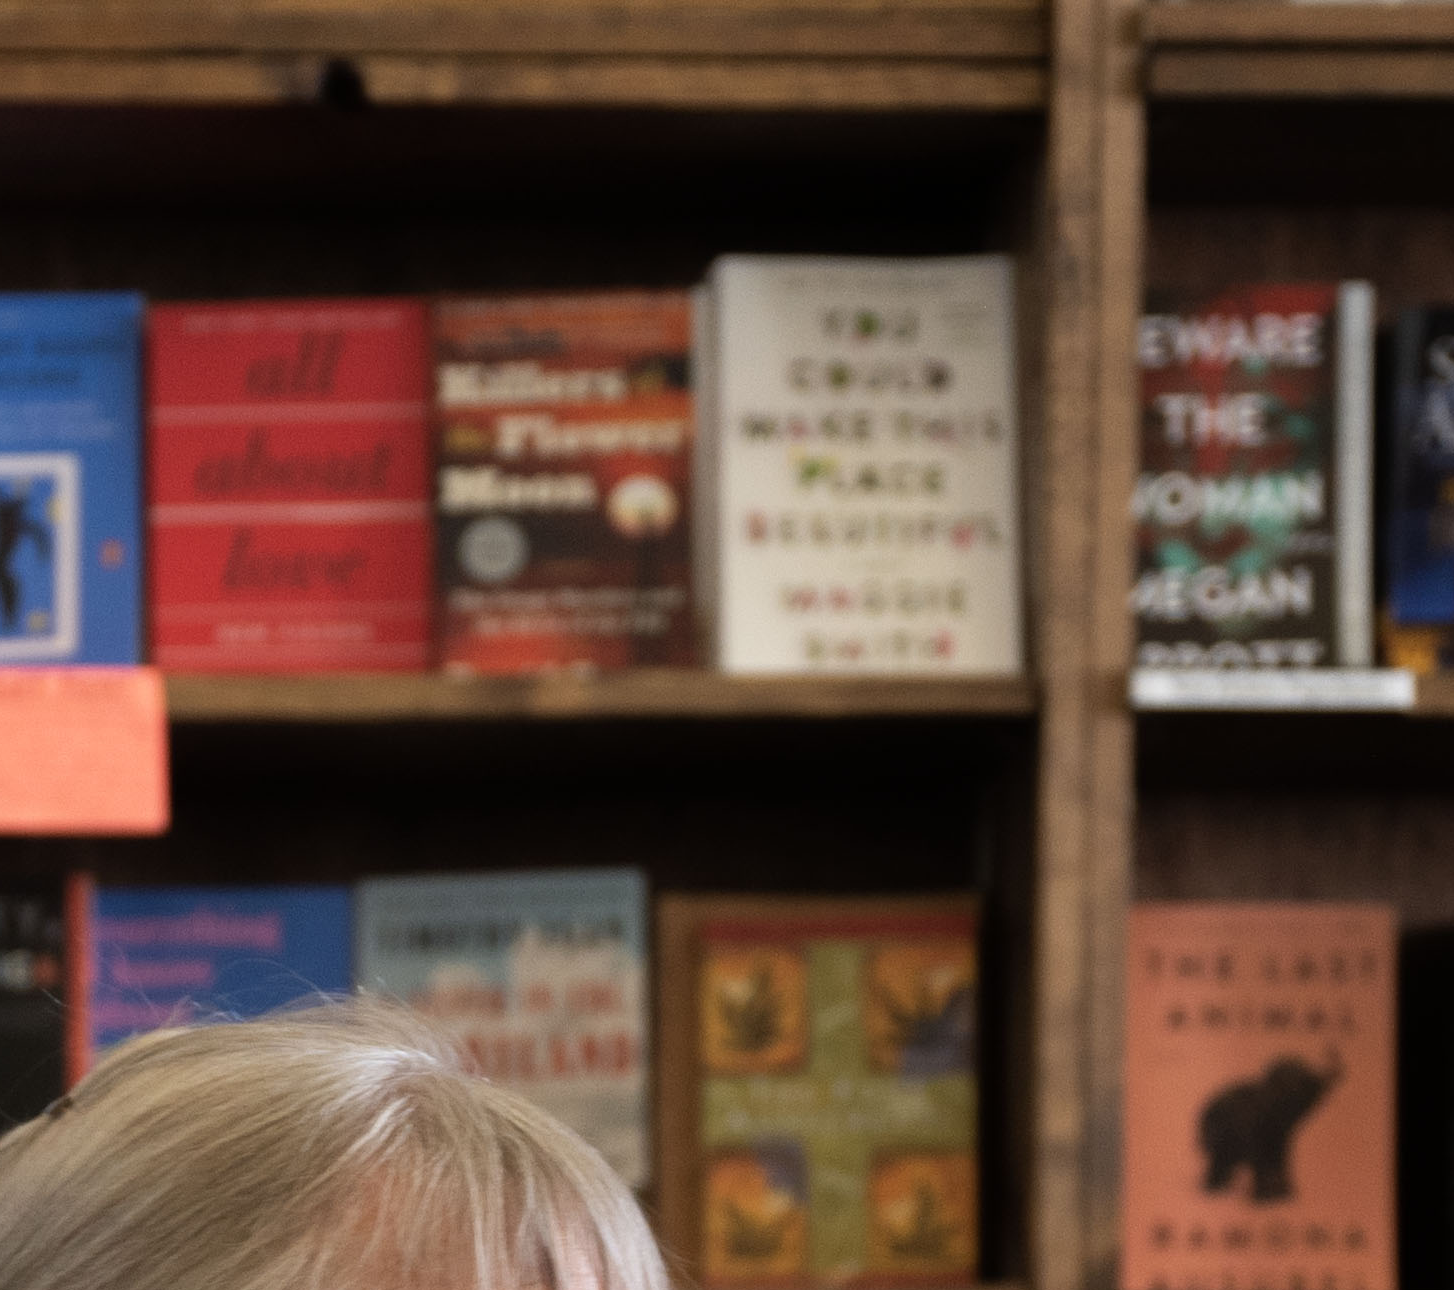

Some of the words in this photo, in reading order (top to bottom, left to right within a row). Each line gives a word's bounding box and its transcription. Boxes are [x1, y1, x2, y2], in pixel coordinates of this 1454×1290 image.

[245, 335, 344, 397] all
[1139, 312, 1324, 367] EWARE
[496, 417, 685, 457] Flower
[1158, 396, 1265, 445] THE
[193, 438, 393, 494] about
[438, 468, 598, 510] Moon
[221, 530, 365, 588] love
